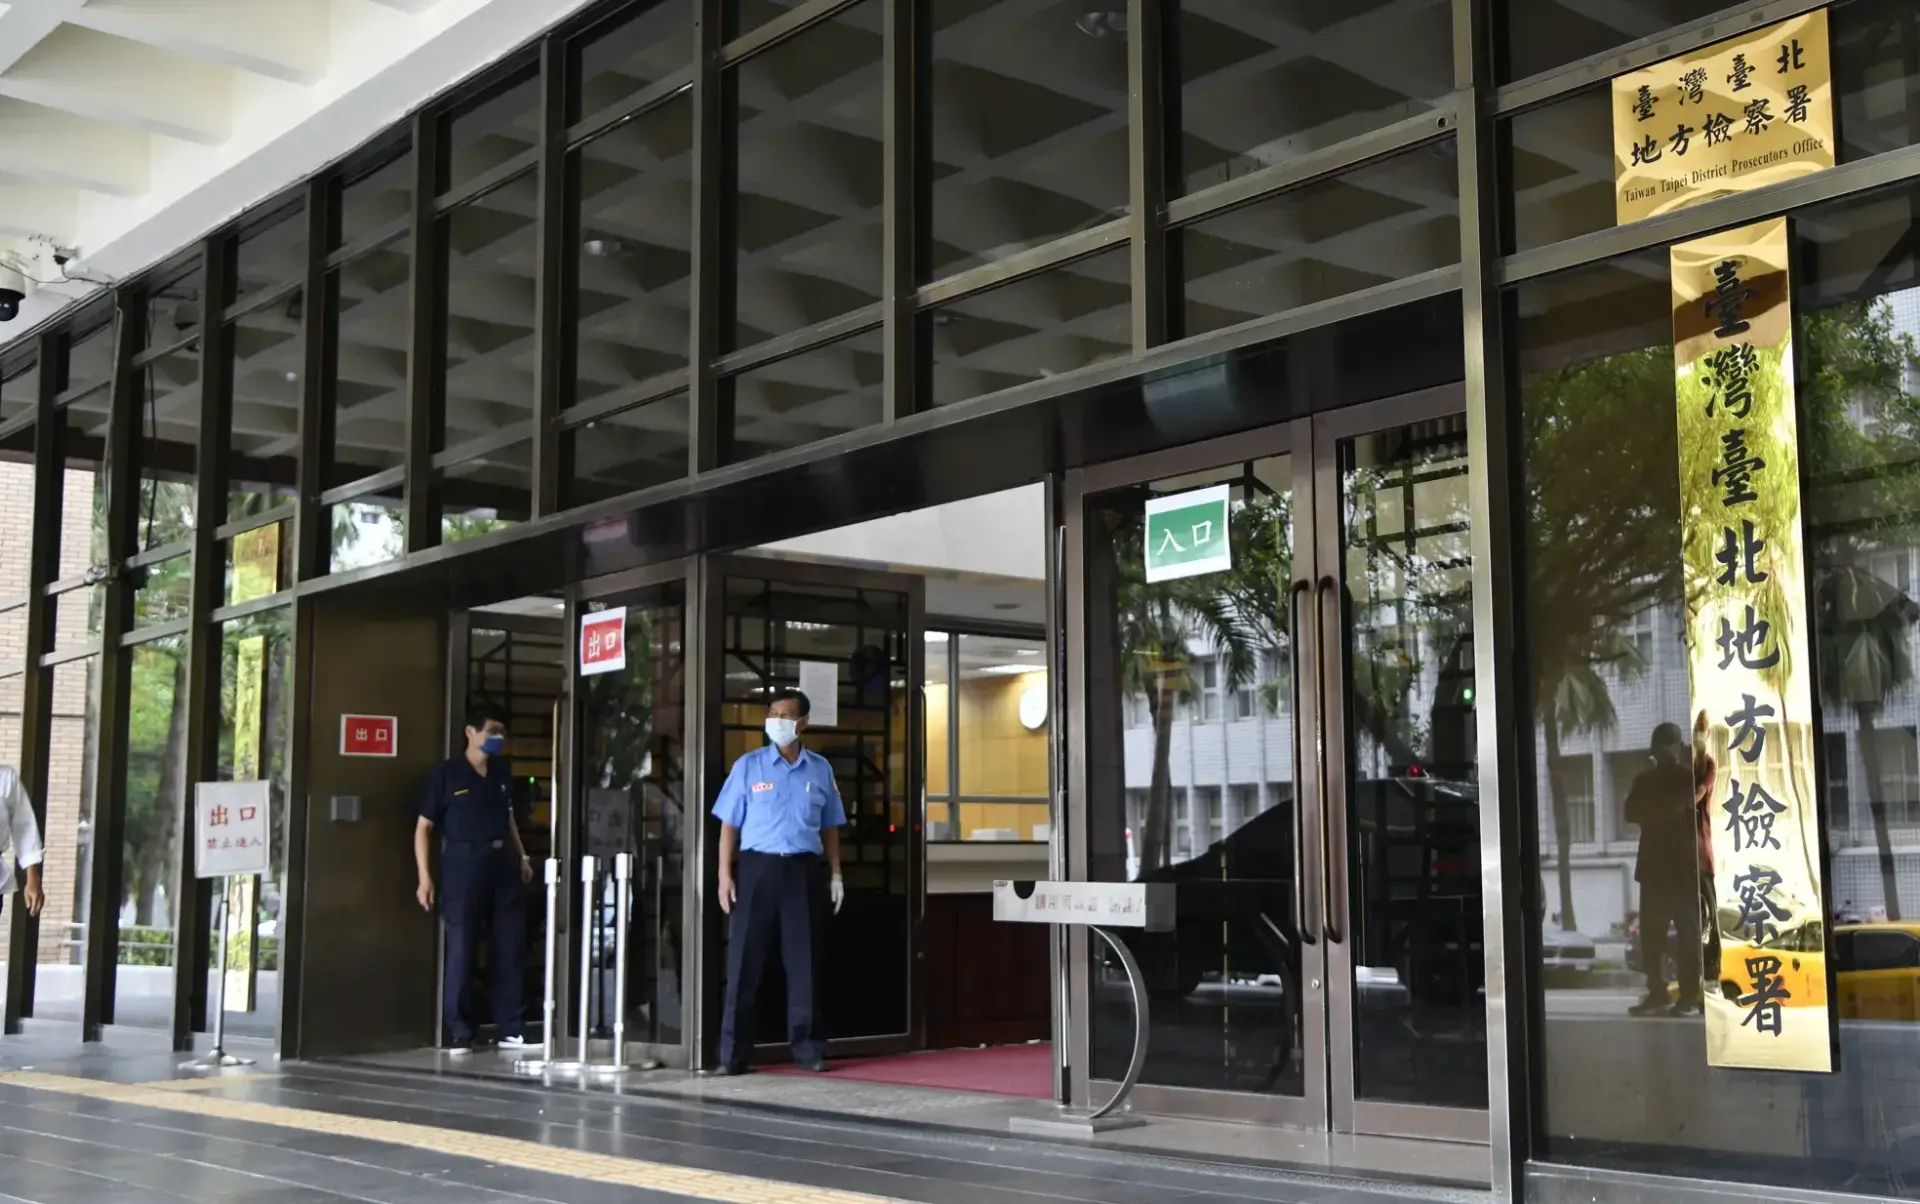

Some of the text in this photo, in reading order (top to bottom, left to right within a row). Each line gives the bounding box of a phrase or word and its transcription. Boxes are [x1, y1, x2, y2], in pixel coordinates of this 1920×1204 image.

[1632, 39, 1806, 122] 臺灣臺北
[1630, 84, 1812, 167] 地方檢察署
[1624, 136, 1824, 203] Taiwan Taipei District Prosecutors Office
[1156, 519, 1213, 556] 入口
[588, 630, 617, 659] 出口
[1701, 260, 1792, 1037] 臺灣臺北地方檢察署
[355, 727, 388, 741] 出口
[210, 804, 256, 826] 出口
